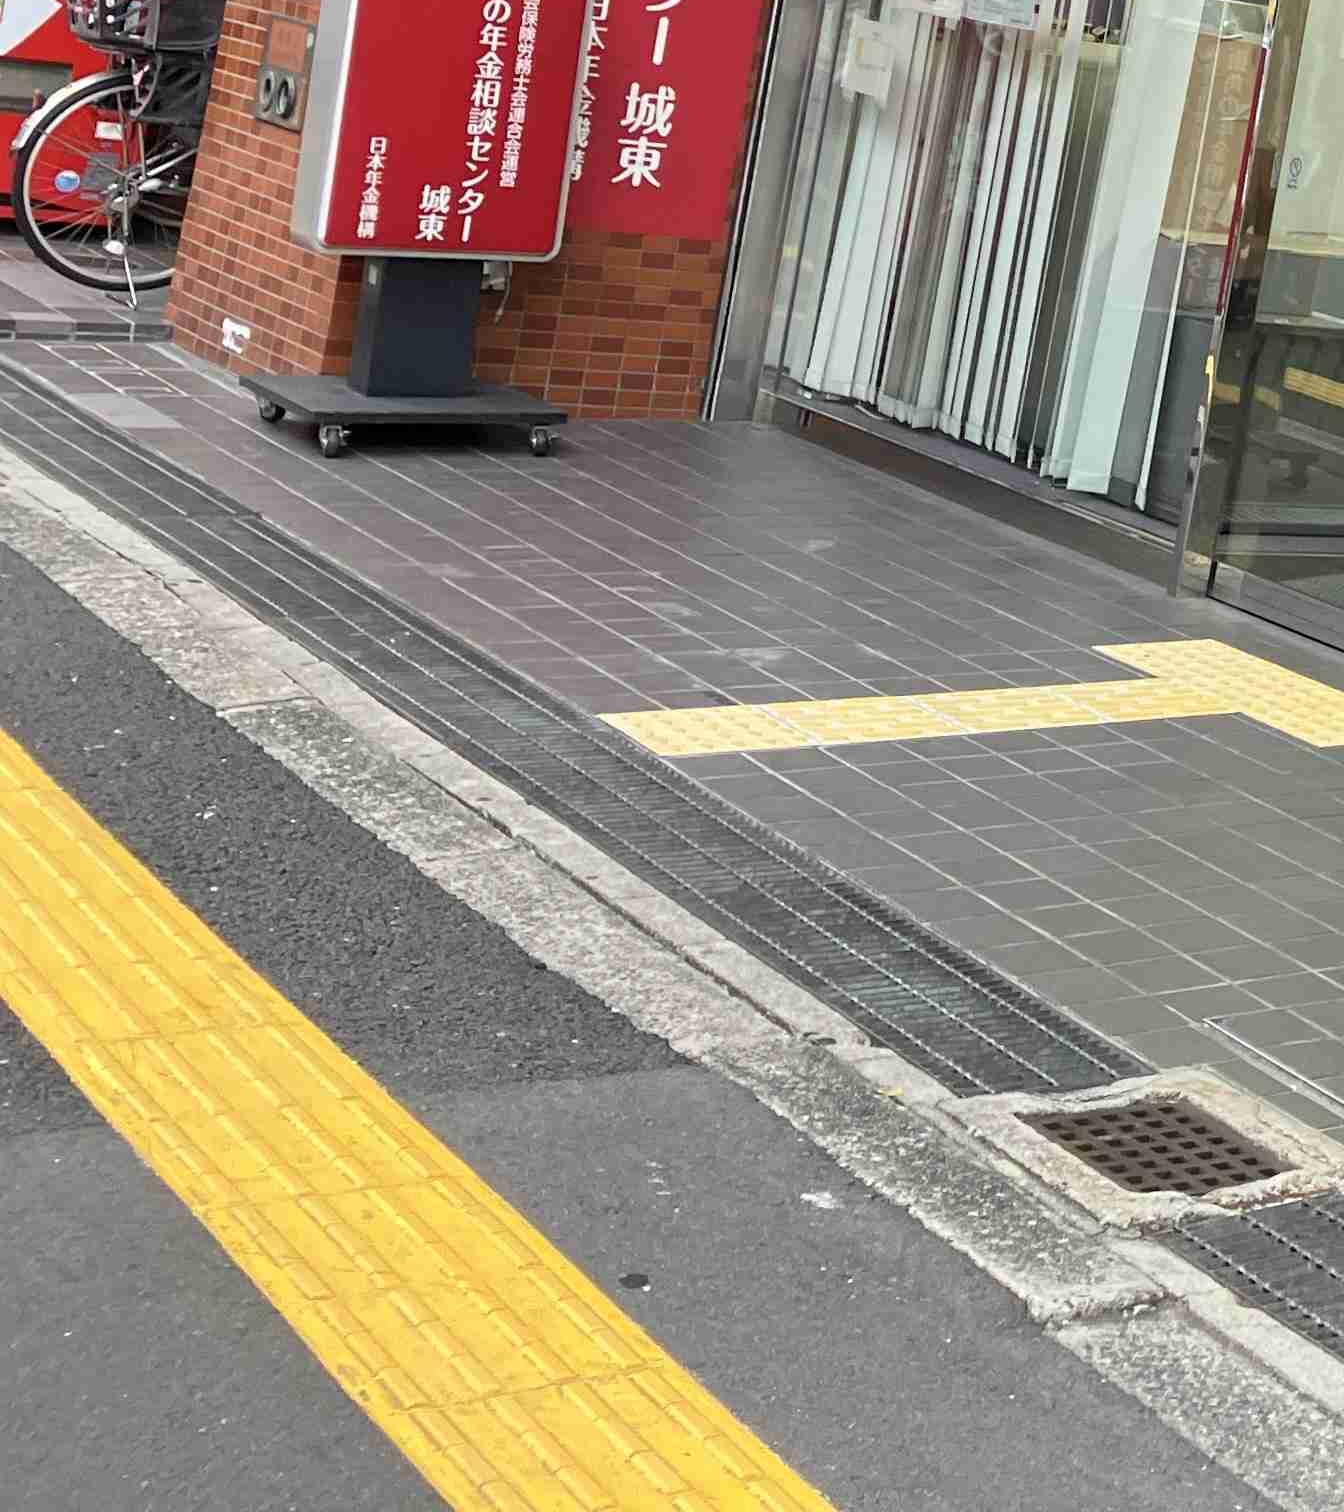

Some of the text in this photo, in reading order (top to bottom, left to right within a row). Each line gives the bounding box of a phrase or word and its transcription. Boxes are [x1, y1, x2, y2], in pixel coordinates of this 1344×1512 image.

[259, 71, 296, 121] 90
[611, 81, 677, 189] 城東
[356, 136, 389, 239] 日本年金機構
[414, 183, 451, 242] 城東
